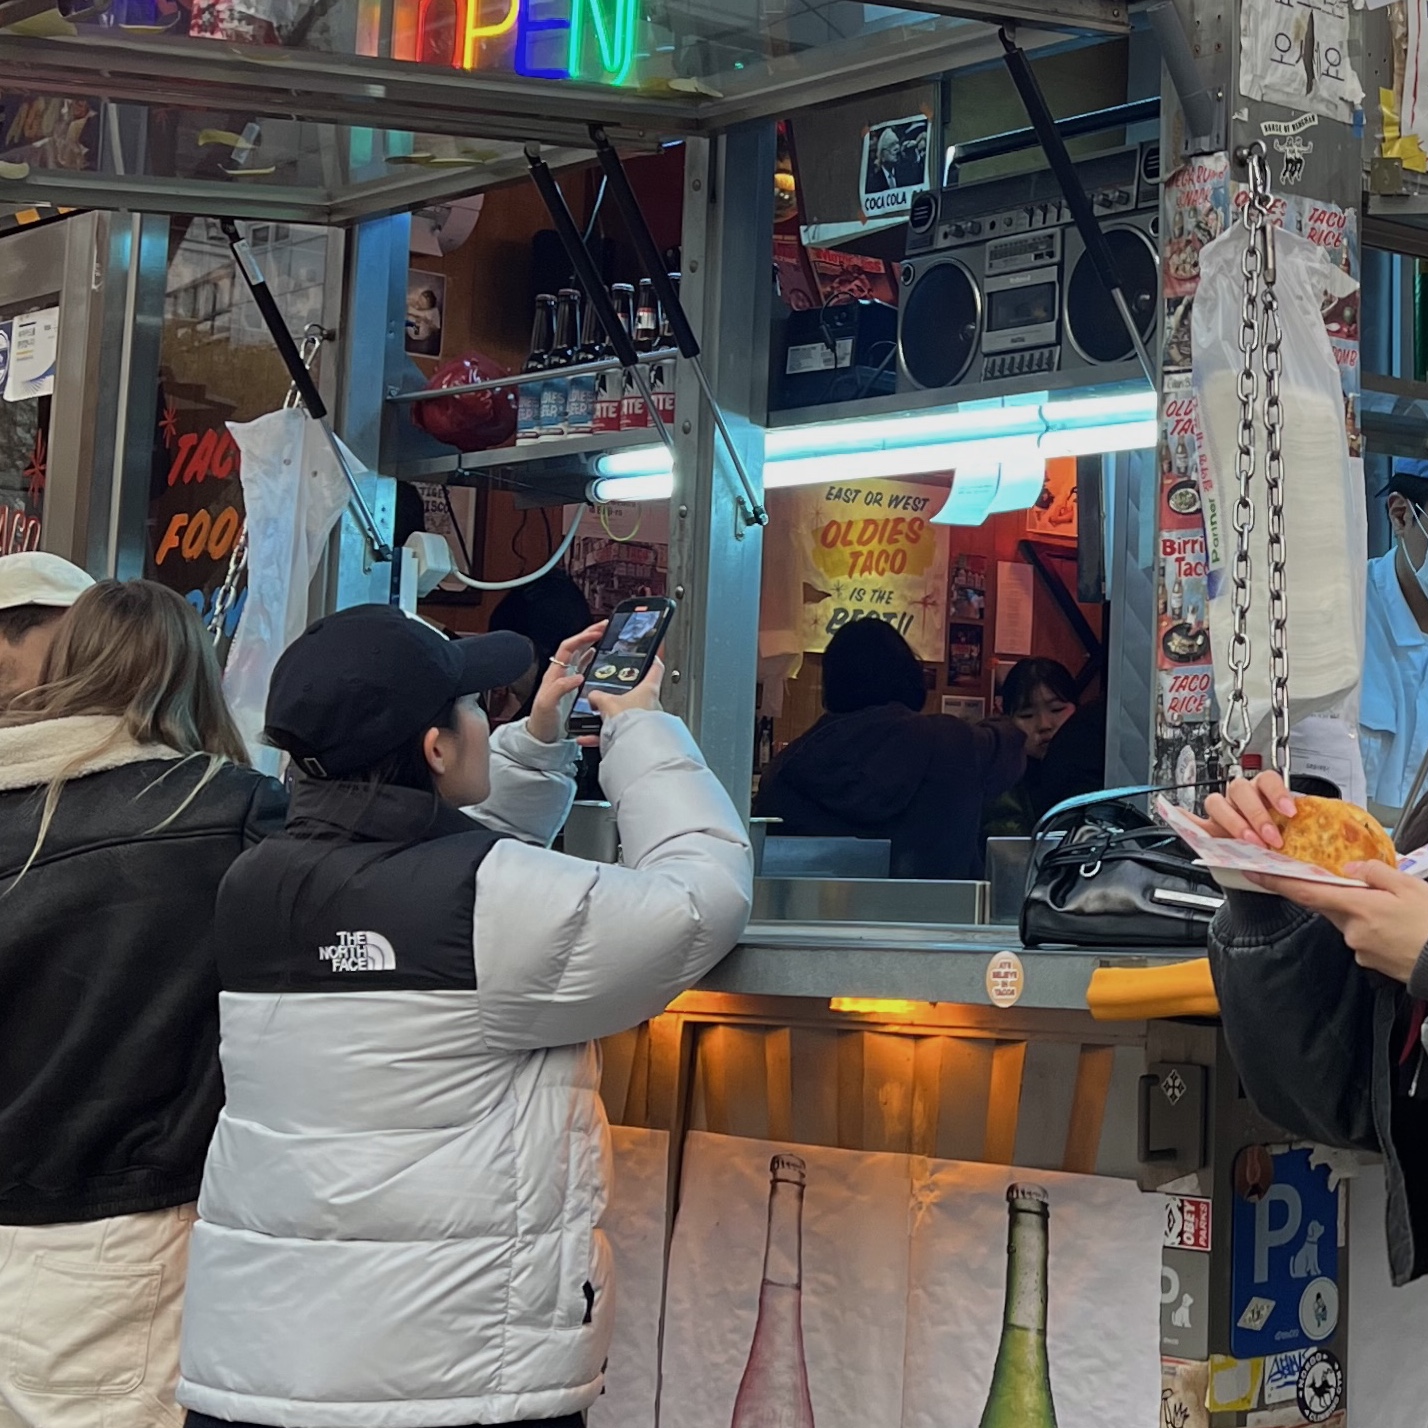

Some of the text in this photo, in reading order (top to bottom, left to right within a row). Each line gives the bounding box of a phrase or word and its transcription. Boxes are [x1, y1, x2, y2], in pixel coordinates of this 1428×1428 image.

[1307, 206, 1347, 229] TACO
[1307, 226, 1343, 248] RICE
[168, 428, 240, 486] TAC
[825, 486, 930, 512] EAST OR WEST
[155, 505, 249, 566] FOO
[820, 516, 925, 550] OLDIES
[1161, 536, 1205, 557] Birri
[848, 548, 908, 580] TACO
[849, 586, 895, 604] IS THE
[1168, 672, 1211, 693] TACO
[1167, 691, 1208, 716] RICE
[336, 931, 367, 946] THE
[318, 945, 367, 961] NORTH
[332, 957, 368, 972] FACE
[1182, 1199, 1195, 1246] OBEY
[1254, 1182, 1303, 1283] P
